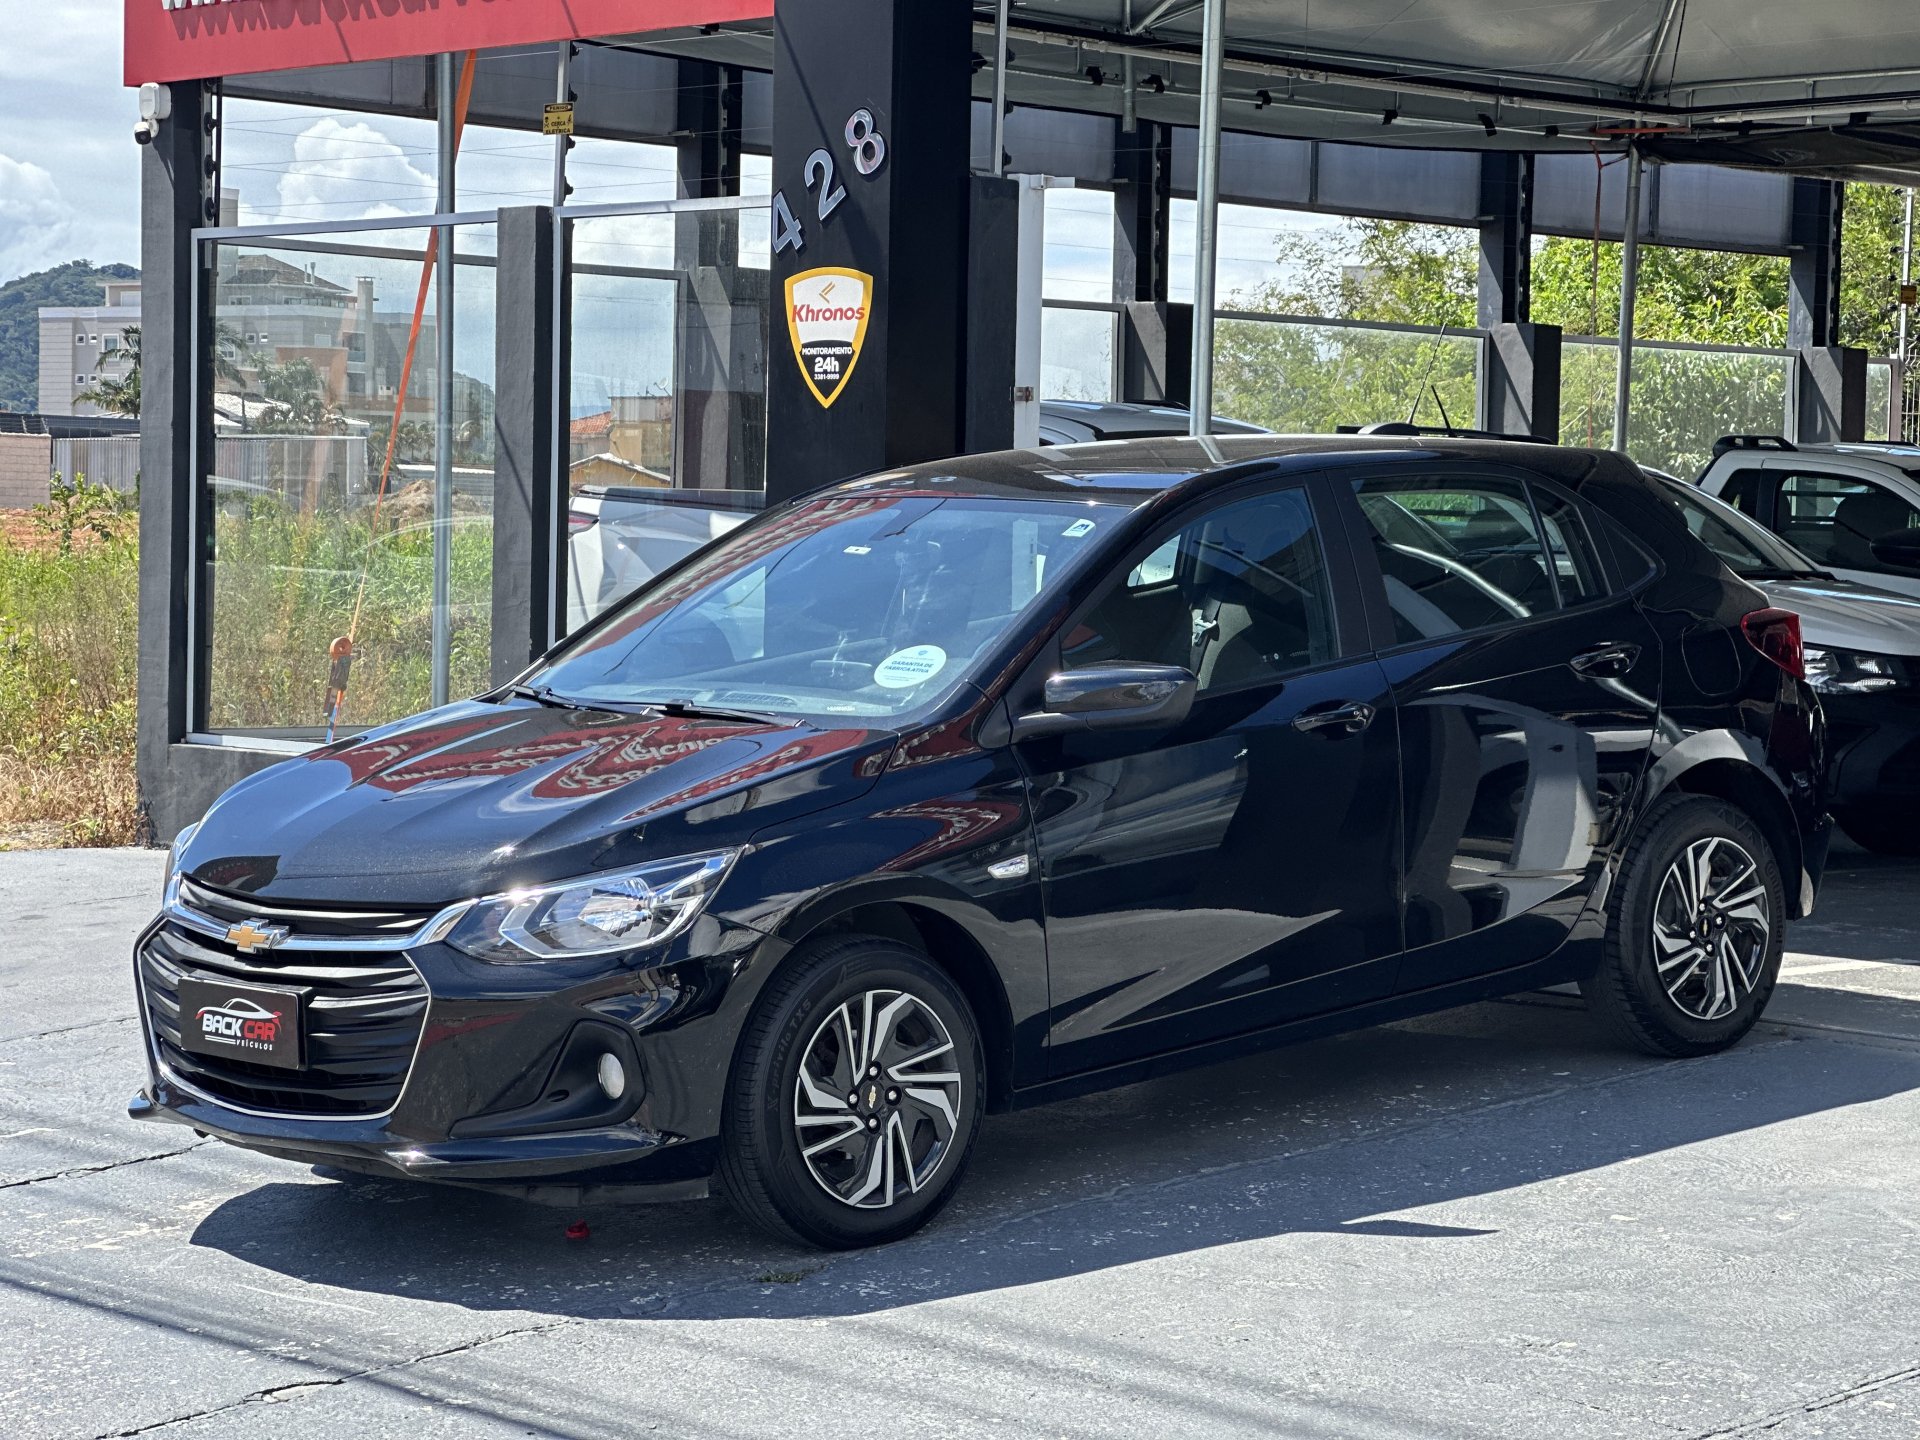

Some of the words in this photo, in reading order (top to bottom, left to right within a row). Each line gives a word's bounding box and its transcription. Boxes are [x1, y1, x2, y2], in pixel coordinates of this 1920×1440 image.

[772, 108, 885, 253] 428
[792, 304, 865, 322] Khronos
[801, 346, 853, 356] MONITORAMENTO
[814, 357, 840, 373] 24h
[202, 1013, 243, 1036] BACK
[243, 1020, 276, 1041] CAR
[236, 1039, 273, 1050] VEÍCULOS
